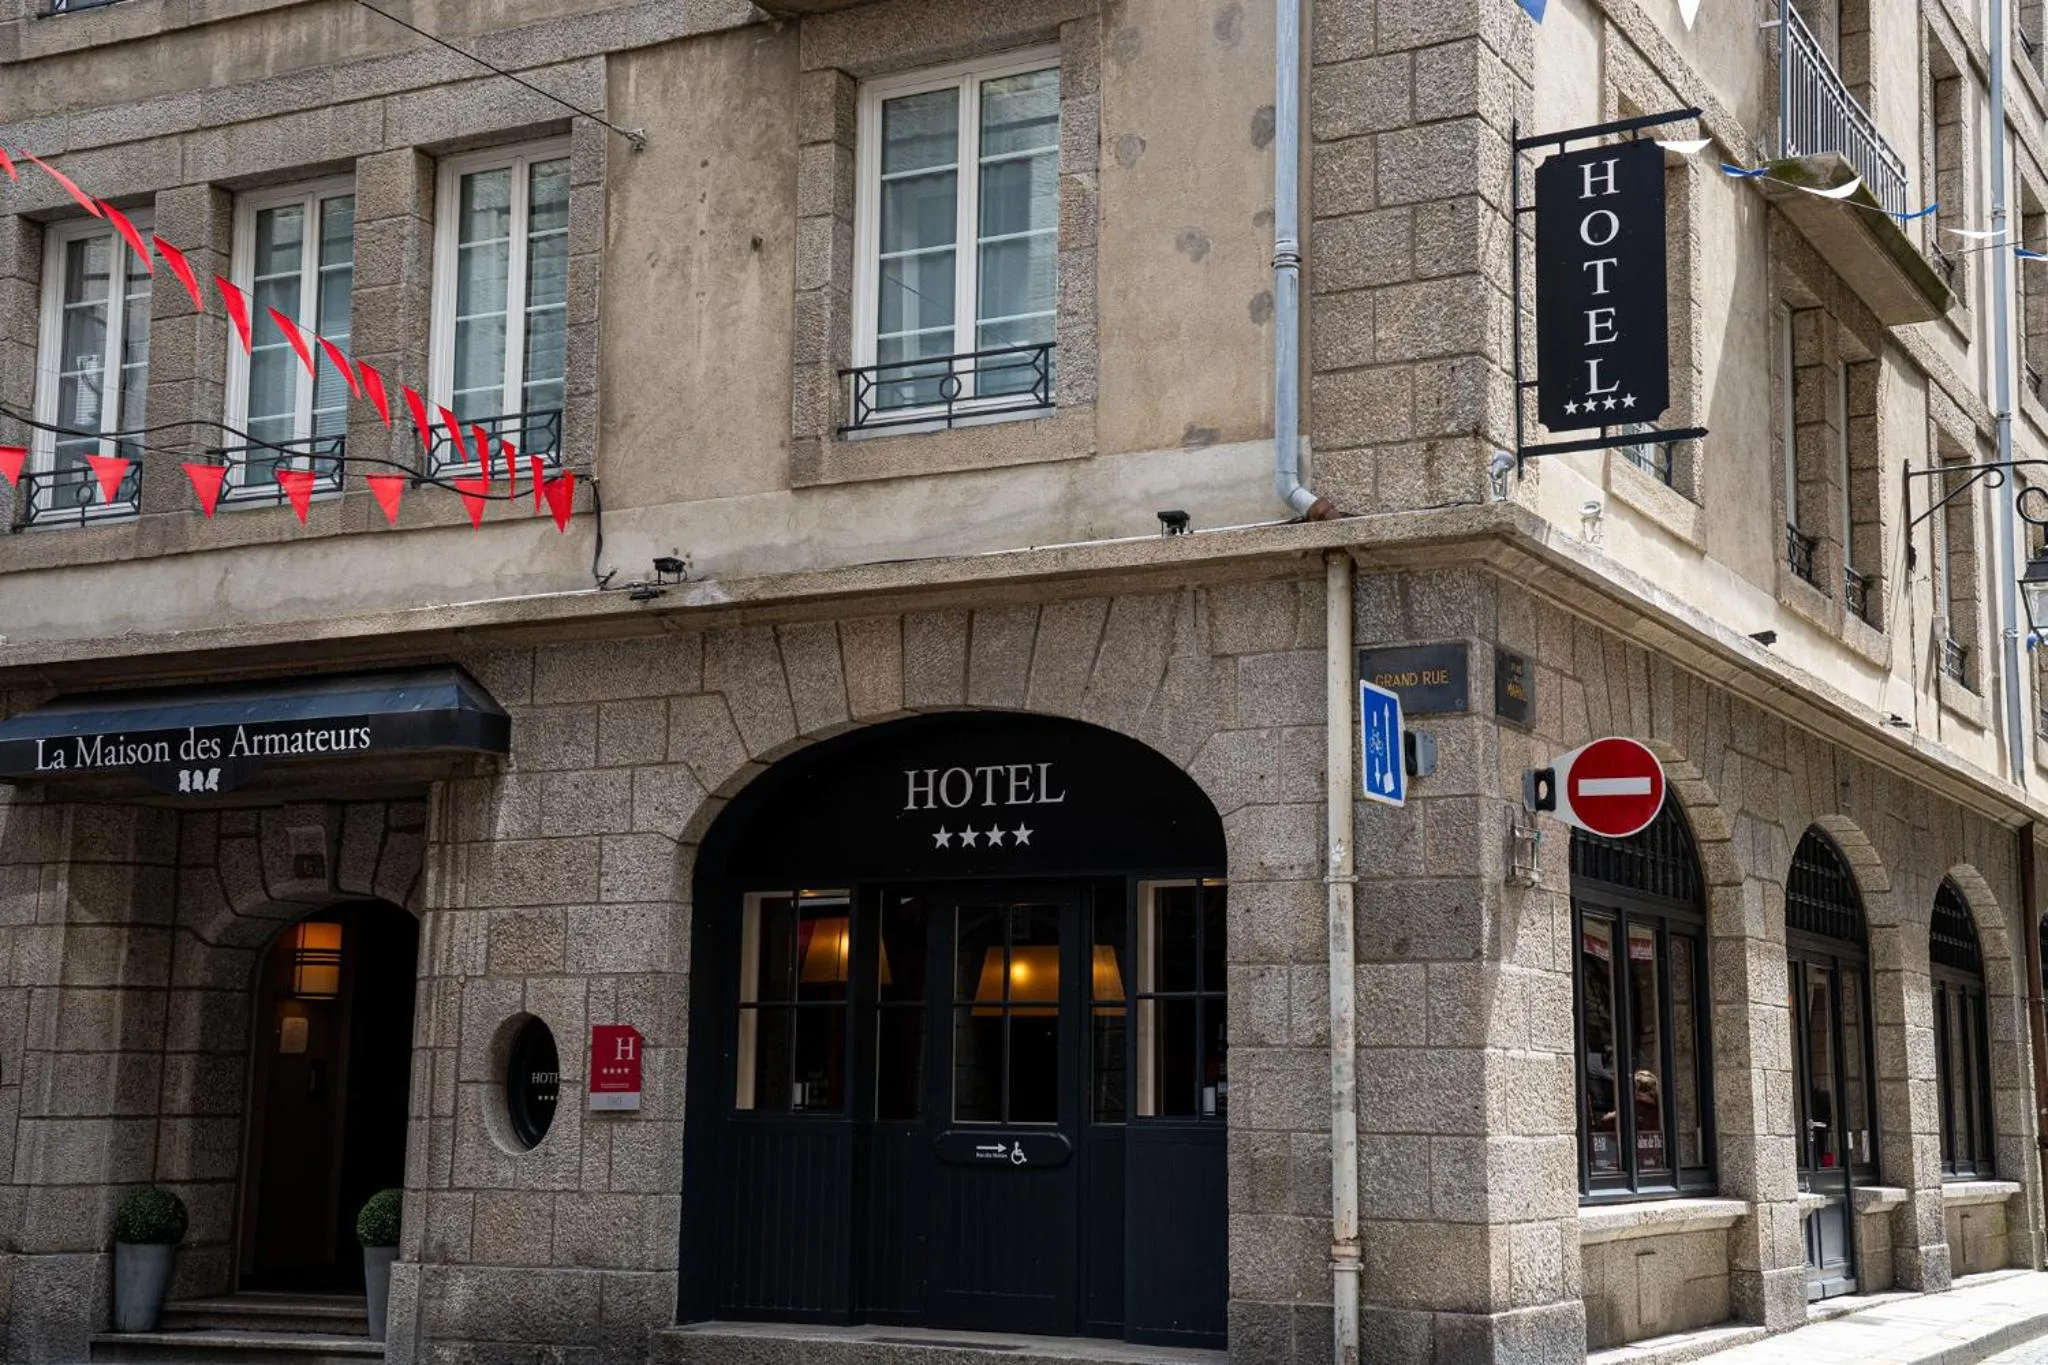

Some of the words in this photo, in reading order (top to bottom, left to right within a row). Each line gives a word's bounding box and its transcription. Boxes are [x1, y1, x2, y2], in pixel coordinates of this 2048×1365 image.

[1578, 158, 1620, 395] HOTEL
[1375, 671, 1418, 687] GRAND
[1422, 669, 1449, 685] RUE
[35, 739, 66, 770] La
[75, 735, 171, 768] Maison
[179, 726, 221, 761] des
[229, 724, 371, 758] Armateurs
[904, 763, 1067, 811] HOTEL
[615, 1036, 636, 1060] H
